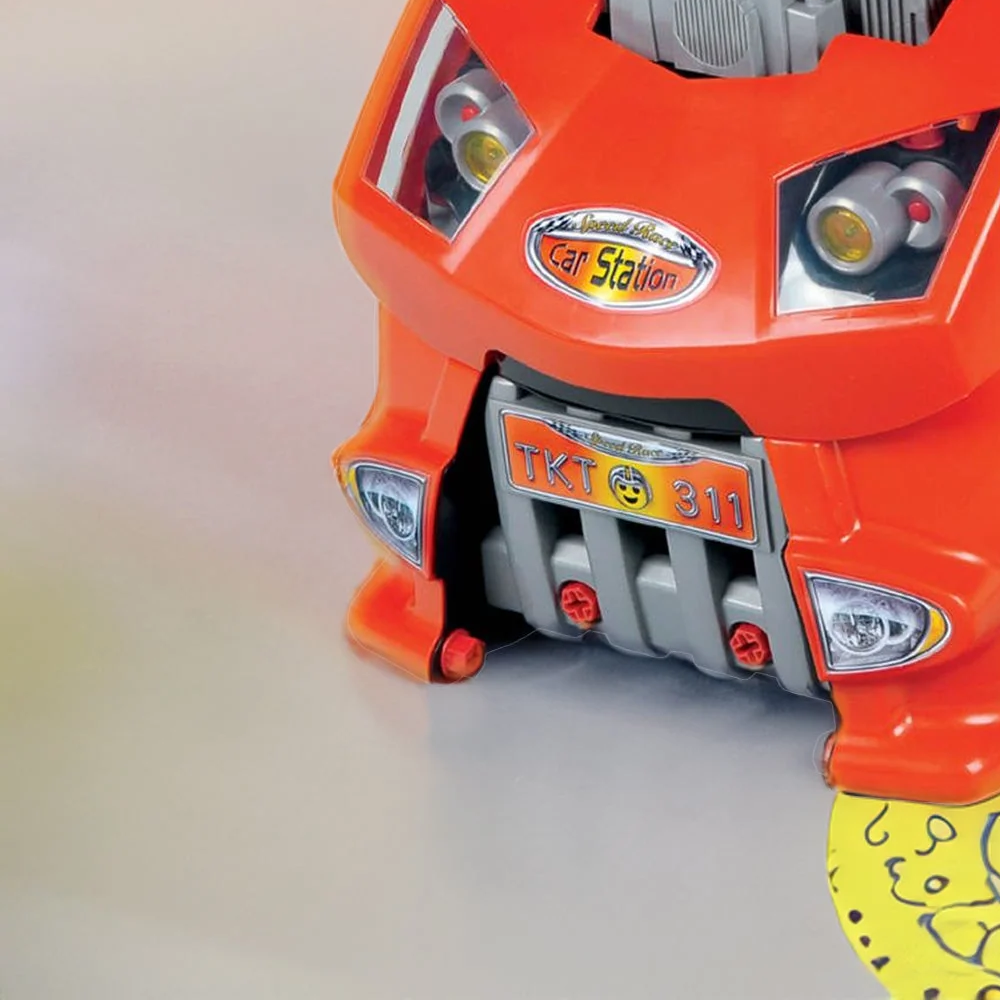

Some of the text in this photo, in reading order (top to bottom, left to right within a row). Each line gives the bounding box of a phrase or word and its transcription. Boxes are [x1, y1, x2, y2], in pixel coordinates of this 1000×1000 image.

[549, 243, 678, 292] Car Station
[514, 442, 744, 530] TKT 311
